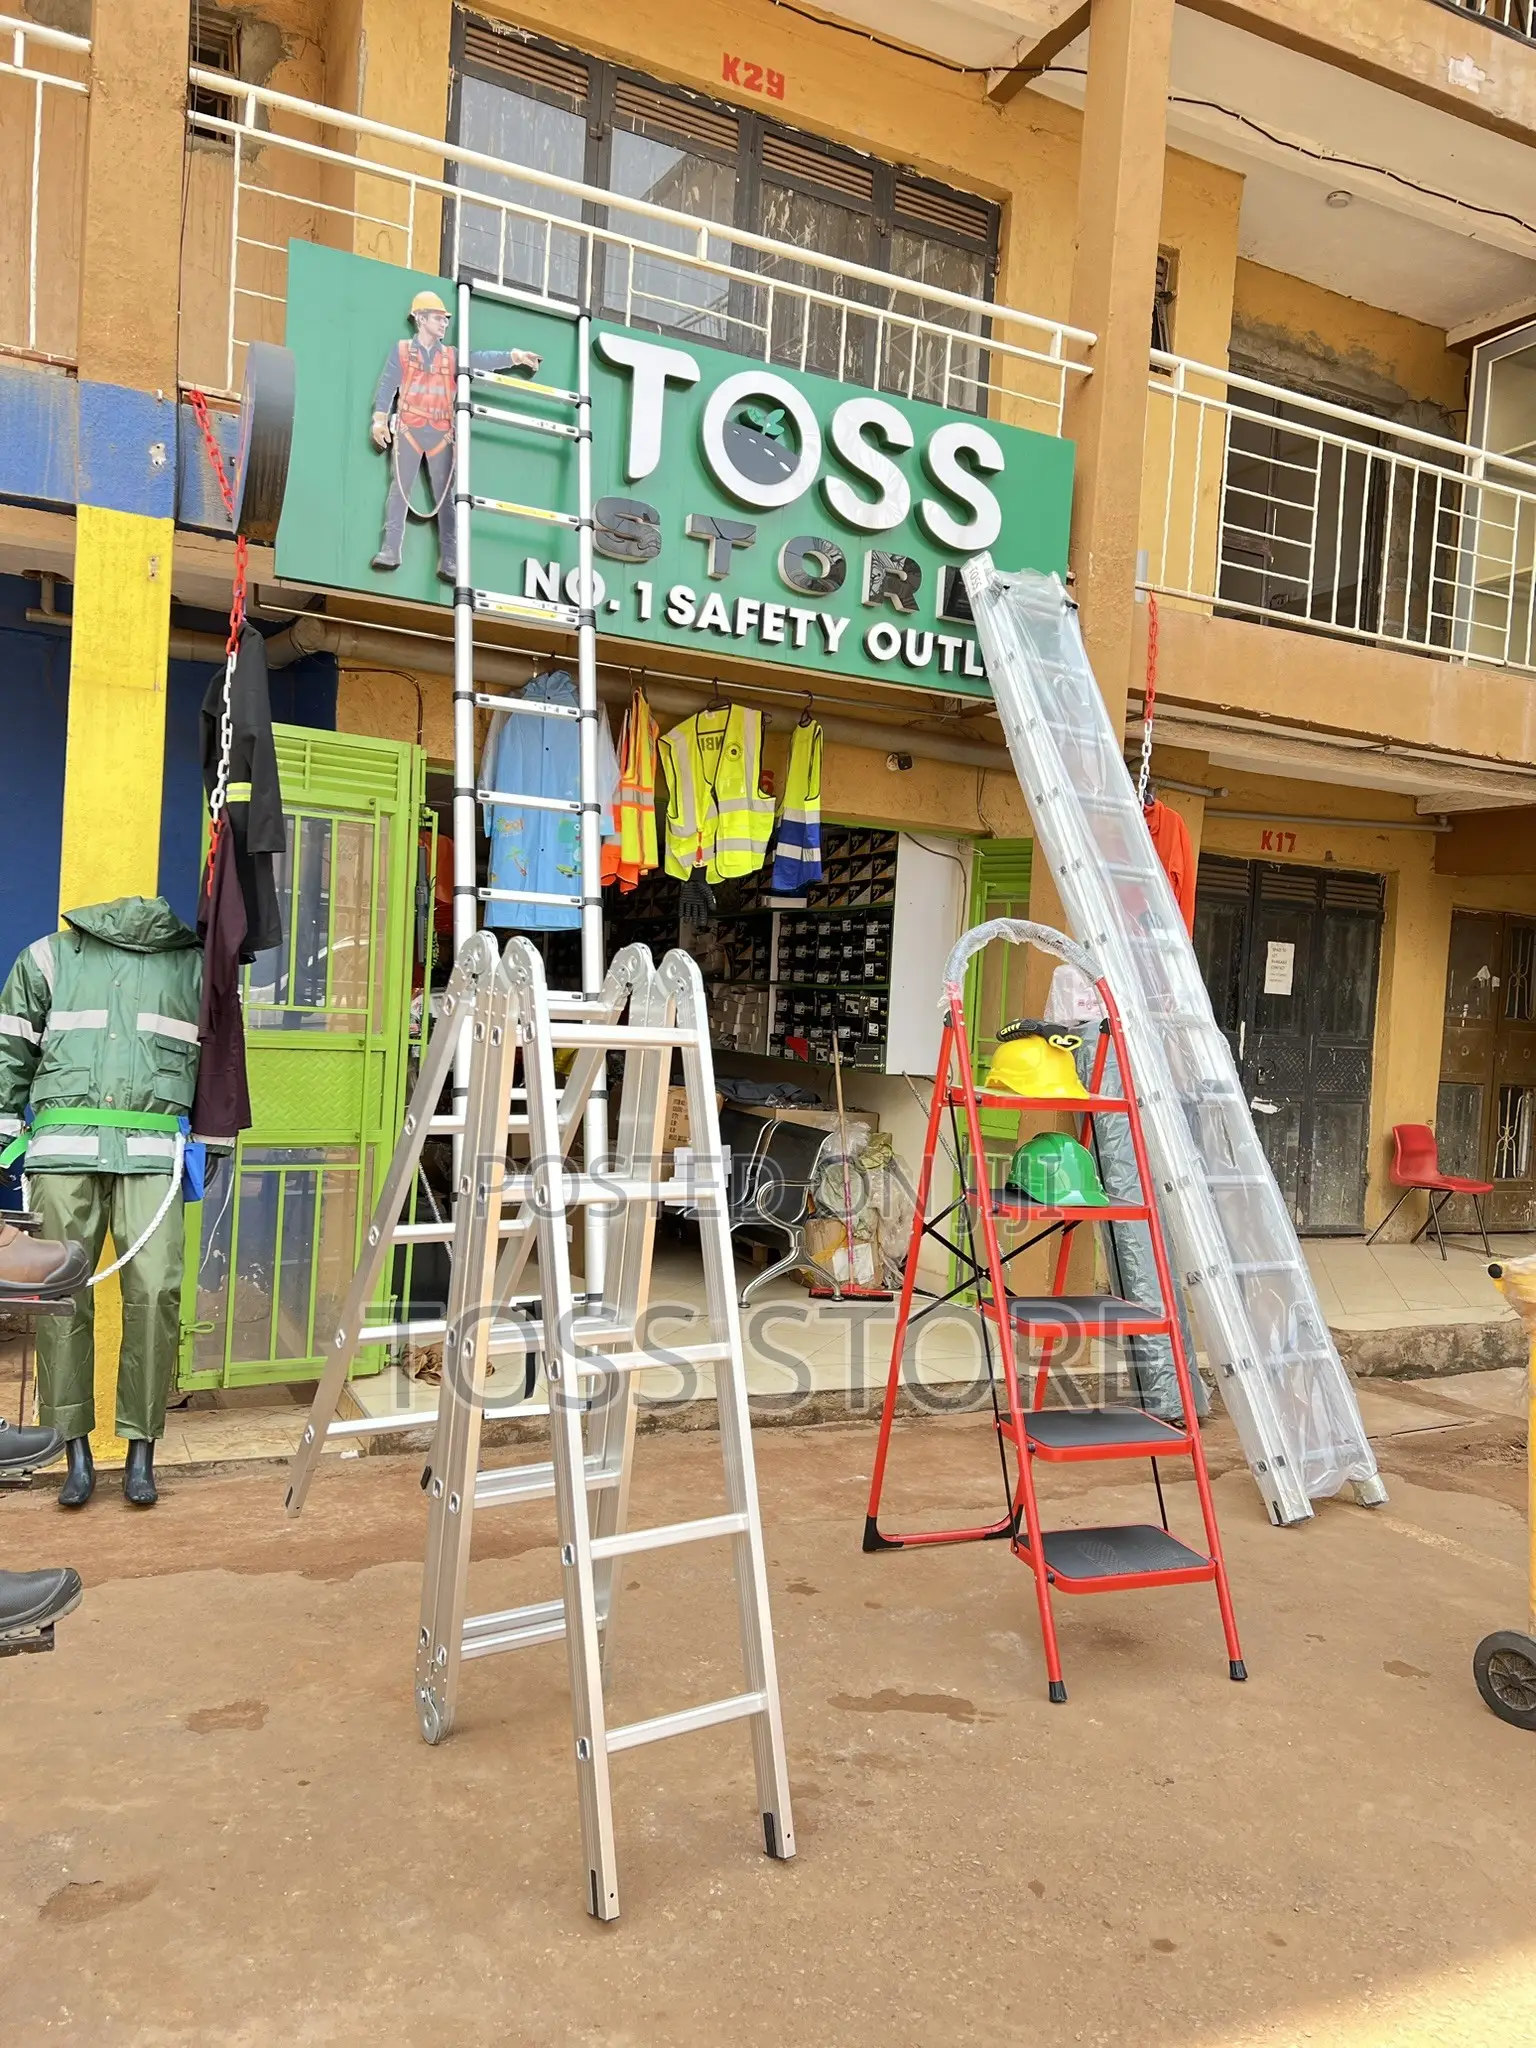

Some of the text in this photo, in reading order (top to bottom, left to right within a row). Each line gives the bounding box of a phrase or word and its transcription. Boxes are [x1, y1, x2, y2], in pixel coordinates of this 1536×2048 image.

[722, 52, 785, 100] K29
[594, 331, 1005, 551] TOSS
[524, 557, 985, 678] NO. 1 SAFETY OUTL
[1261, 830, 1296, 853] K17
